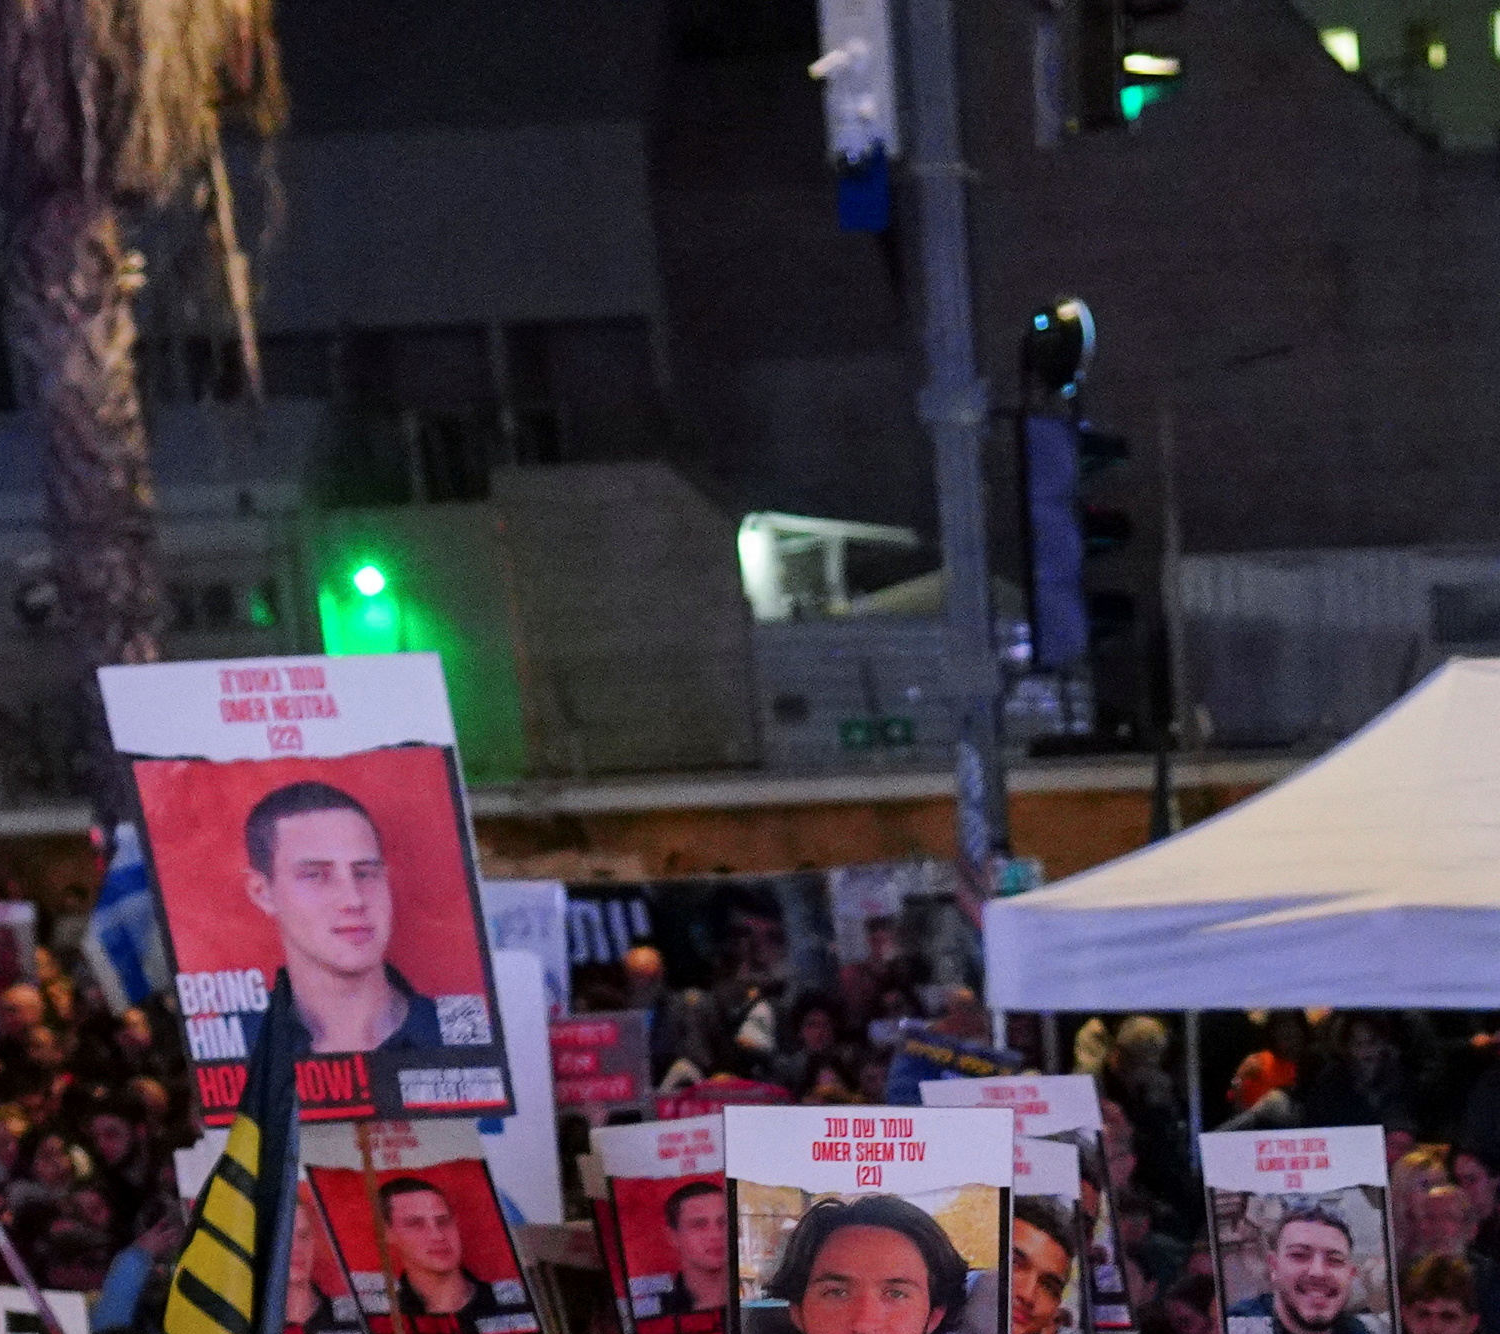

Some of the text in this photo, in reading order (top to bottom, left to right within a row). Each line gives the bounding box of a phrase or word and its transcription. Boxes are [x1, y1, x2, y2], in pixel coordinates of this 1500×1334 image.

[176, 969, 268, 1016] BRING
[186, 1016, 246, 1060] HIM
[879, 1118, 913, 1138] עומר
[812, 1142, 925, 1162] OMER SHEM TOV
[856, 1165, 882, 1187] (21)
